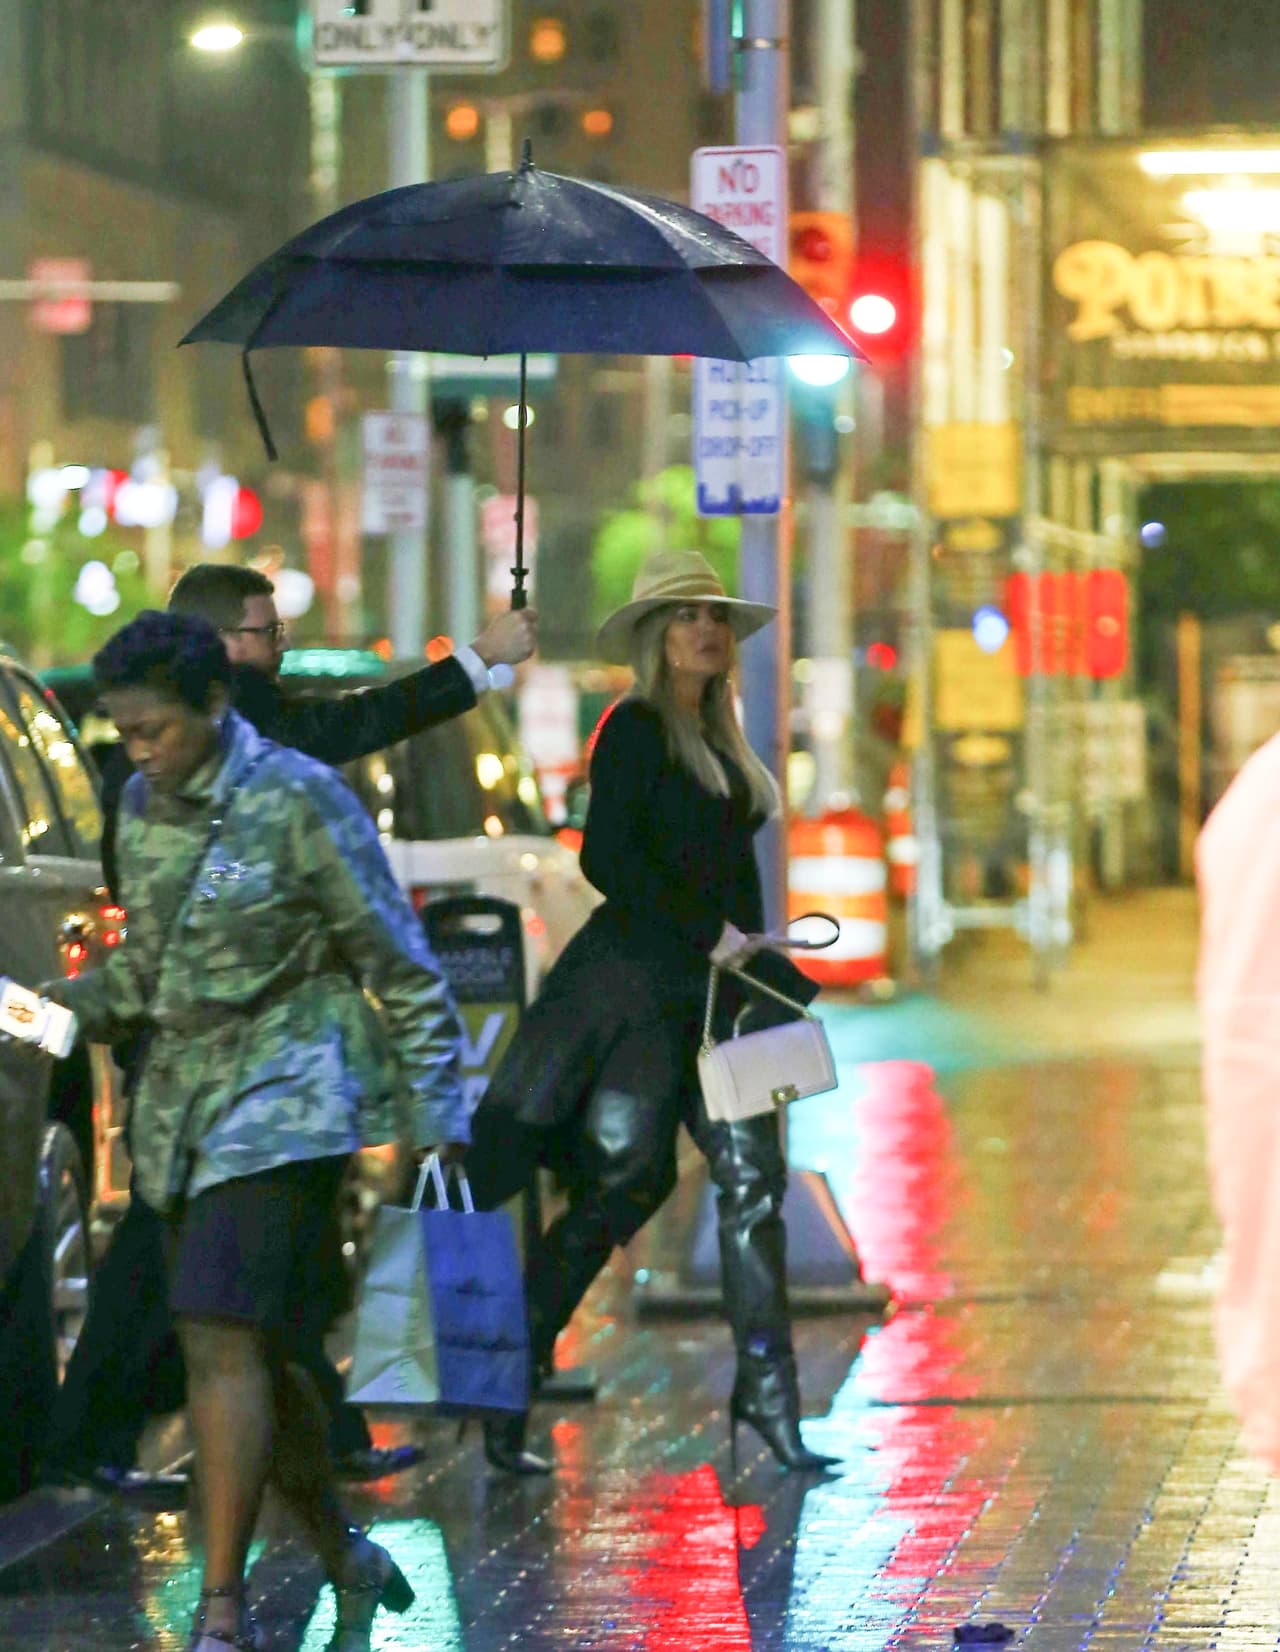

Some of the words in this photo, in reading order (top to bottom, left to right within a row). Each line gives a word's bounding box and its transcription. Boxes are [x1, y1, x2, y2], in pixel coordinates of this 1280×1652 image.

[317, 22, 404, 49] ONLY
[411, 22, 496, 49] ONLY
[718, 162, 760, 194] NO
[709, 399, 768, 420] PICK-UP
[700, 436, 776, 457] DROP-OFF
